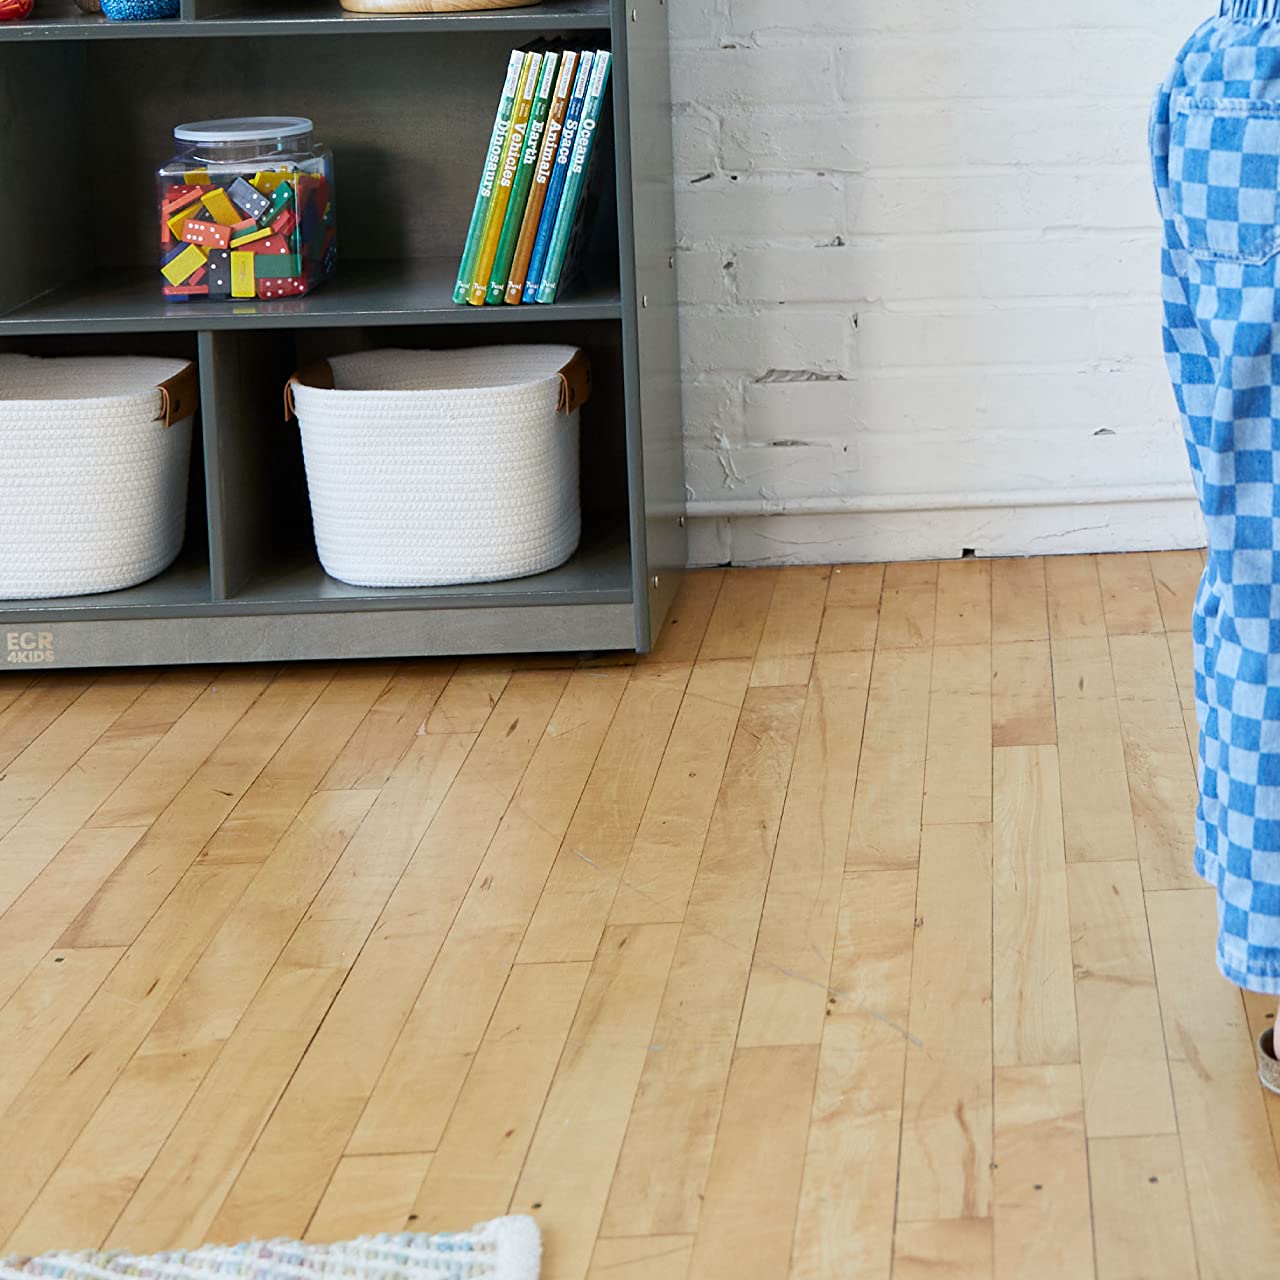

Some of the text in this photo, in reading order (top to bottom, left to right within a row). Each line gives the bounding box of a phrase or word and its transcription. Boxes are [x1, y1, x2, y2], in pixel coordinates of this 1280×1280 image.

[481, 120, 510, 197] Dinosaurs
[501, 122, 527, 187] Vehicles
[523, 120, 545, 165] Earth
[536, 119, 561, 184] Animals
[558, 120, 578, 165] Space
[573, 119, 595, 174] Oceans
[7, 631, 54, 650] ECR
[7, 650, 56, 664] 4KIDS
